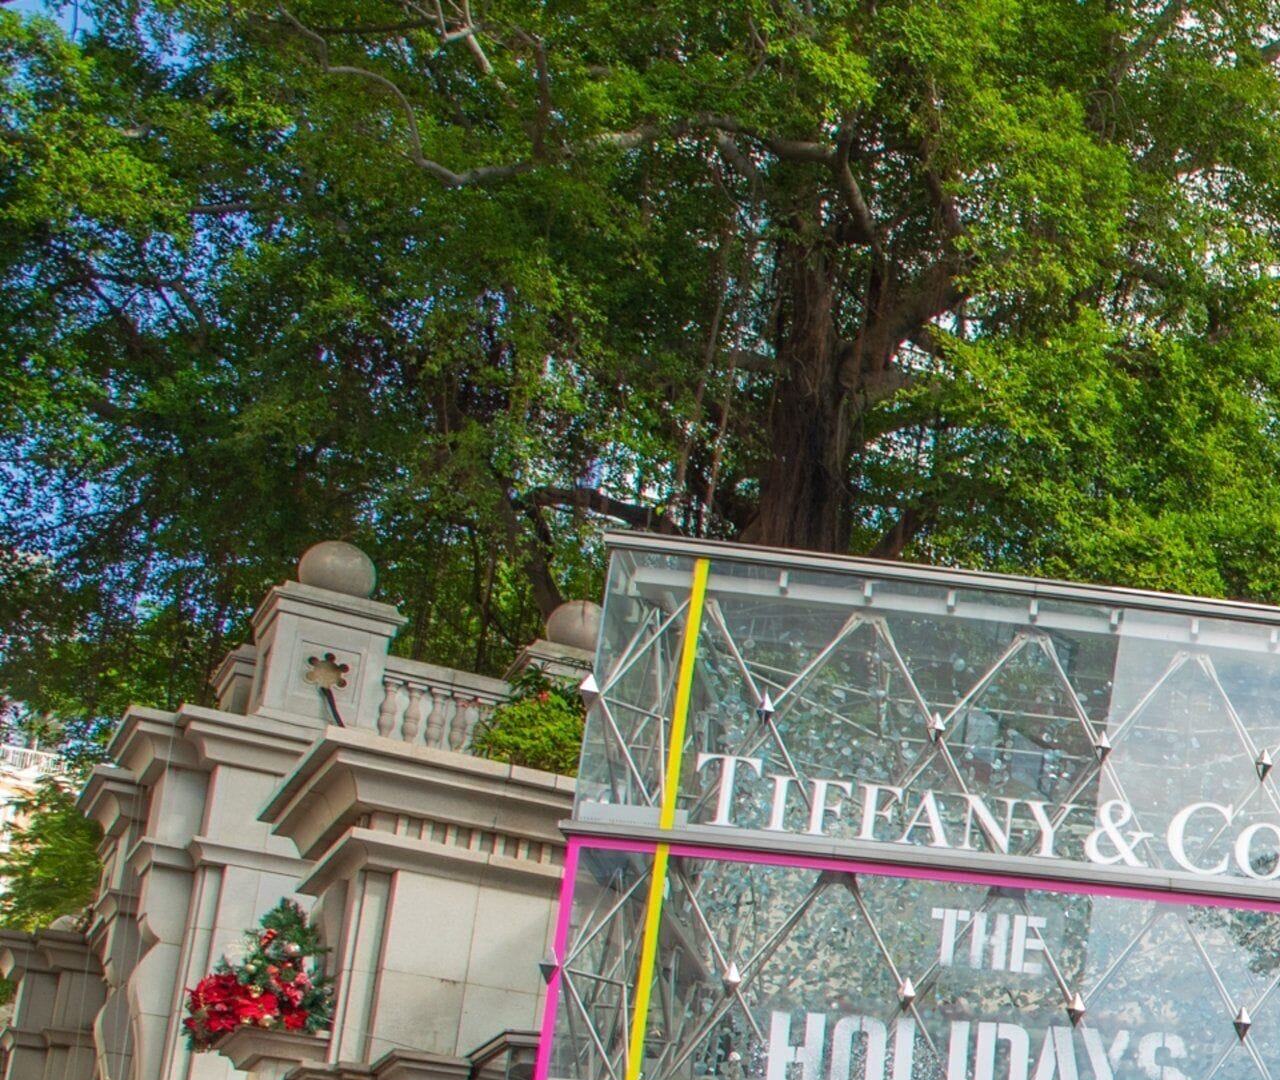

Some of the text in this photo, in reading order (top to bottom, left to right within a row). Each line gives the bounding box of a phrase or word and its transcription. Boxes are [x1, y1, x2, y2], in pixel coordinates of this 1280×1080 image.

[697, 751, 1072, 859] TIFFANY
[1084, 799, 1154, 867] &
[931, 906, 1048, 974] THE
